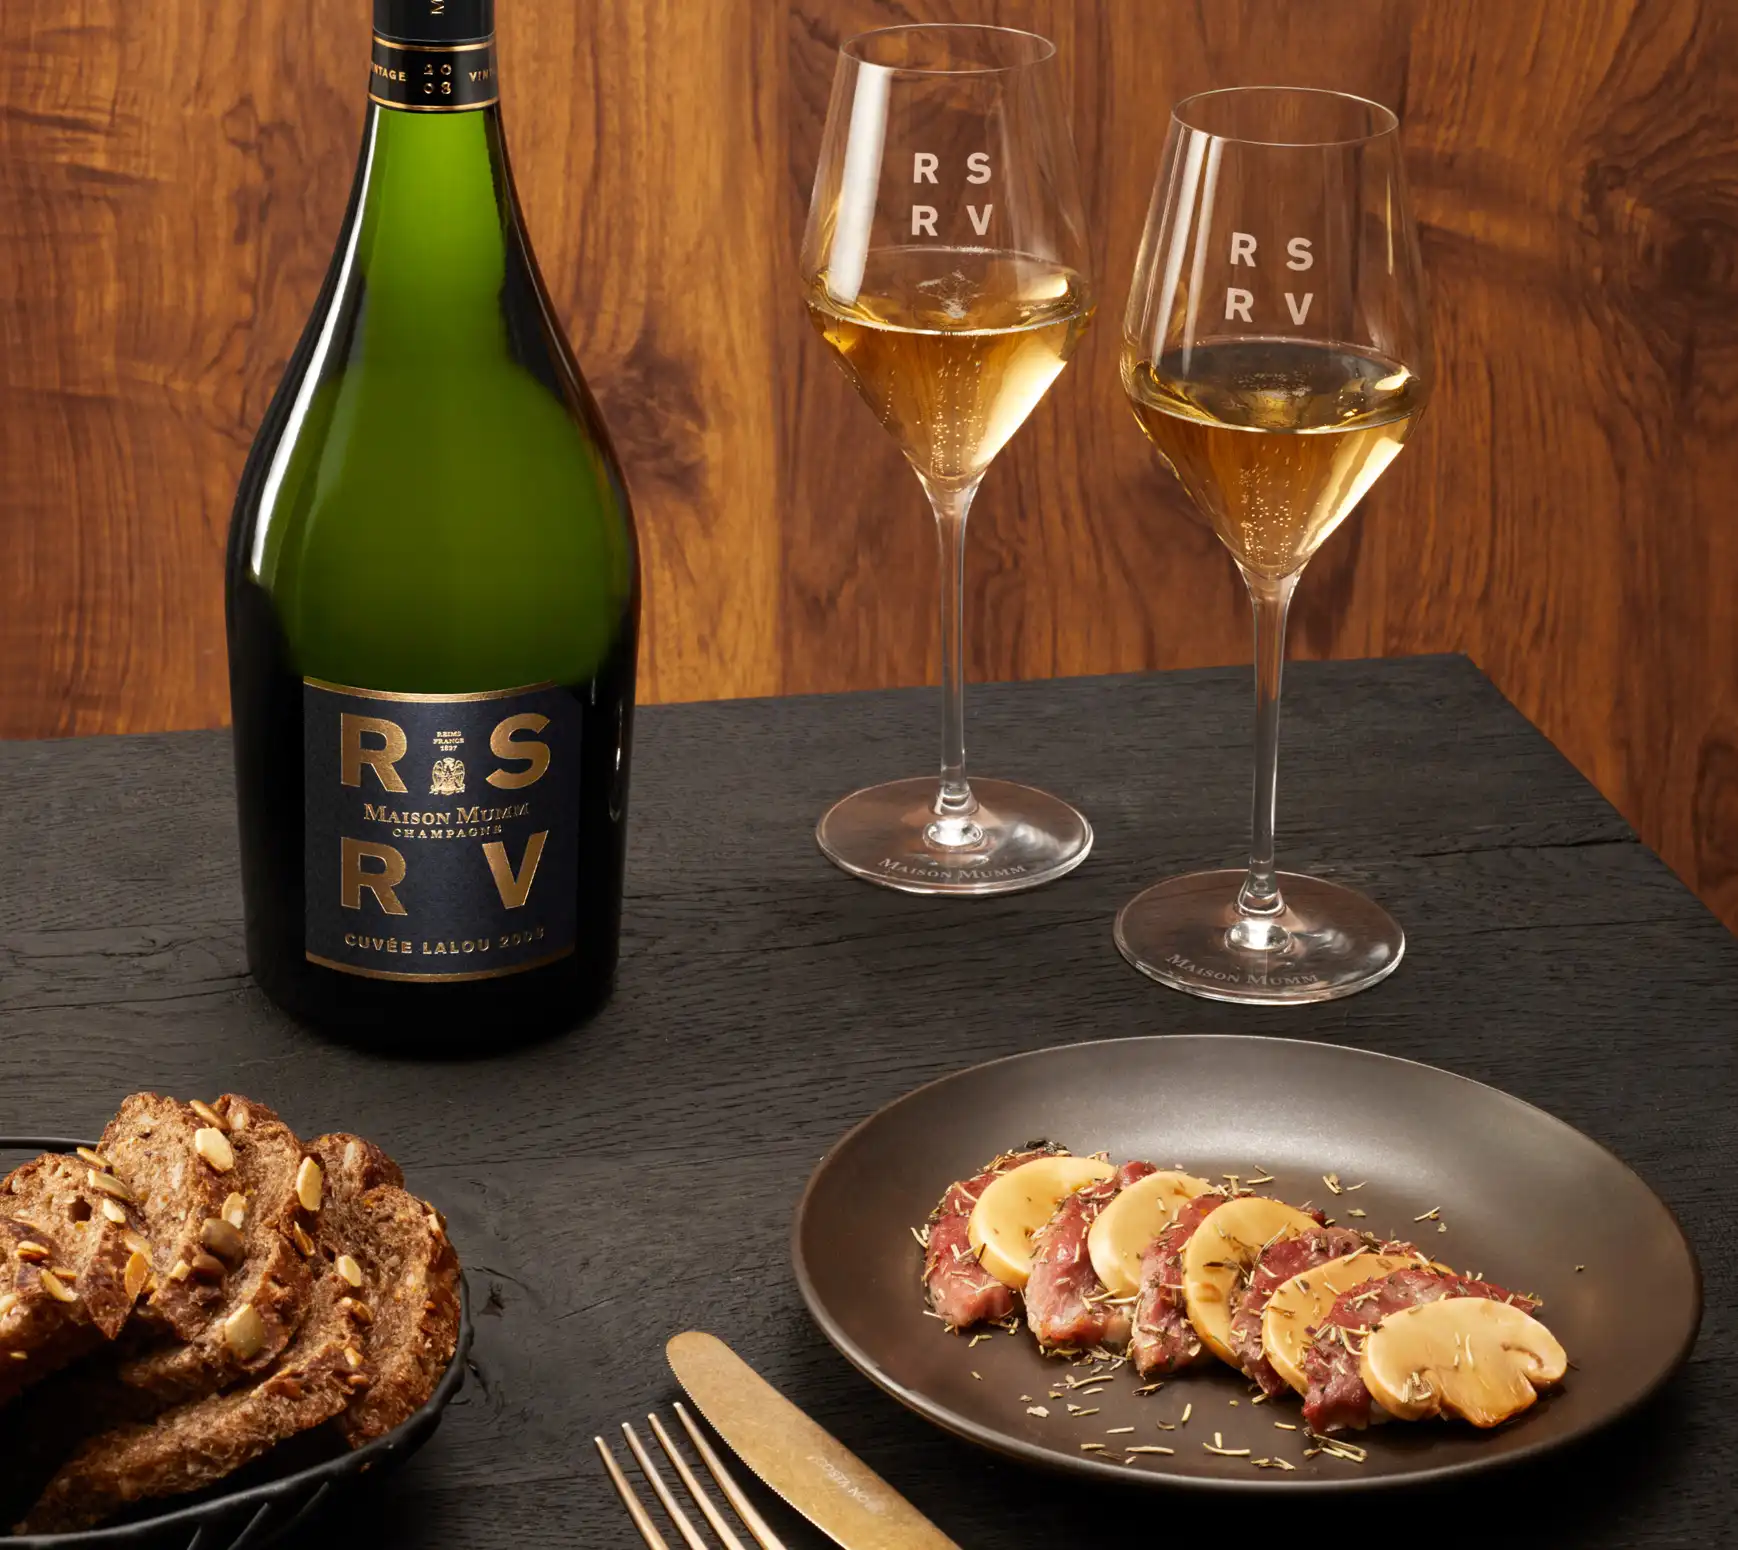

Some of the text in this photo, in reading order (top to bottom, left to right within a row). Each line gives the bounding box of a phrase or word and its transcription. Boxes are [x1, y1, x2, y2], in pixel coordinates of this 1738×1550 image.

[913, 152, 992, 185] R S
[911, 204, 993, 236] R V
[1230, 232, 1314, 271] R S
[1225, 287, 1314, 326] R V
[340, 712, 551, 793] R S
[432, 737, 465, 745] FRANCE
[392, 824, 502, 839] CHAMPAGNE
[340, 830, 549, 916] R V
[345, 933, 412, 954] CUVÉE
[422, 938, 490, 955] LALOU
